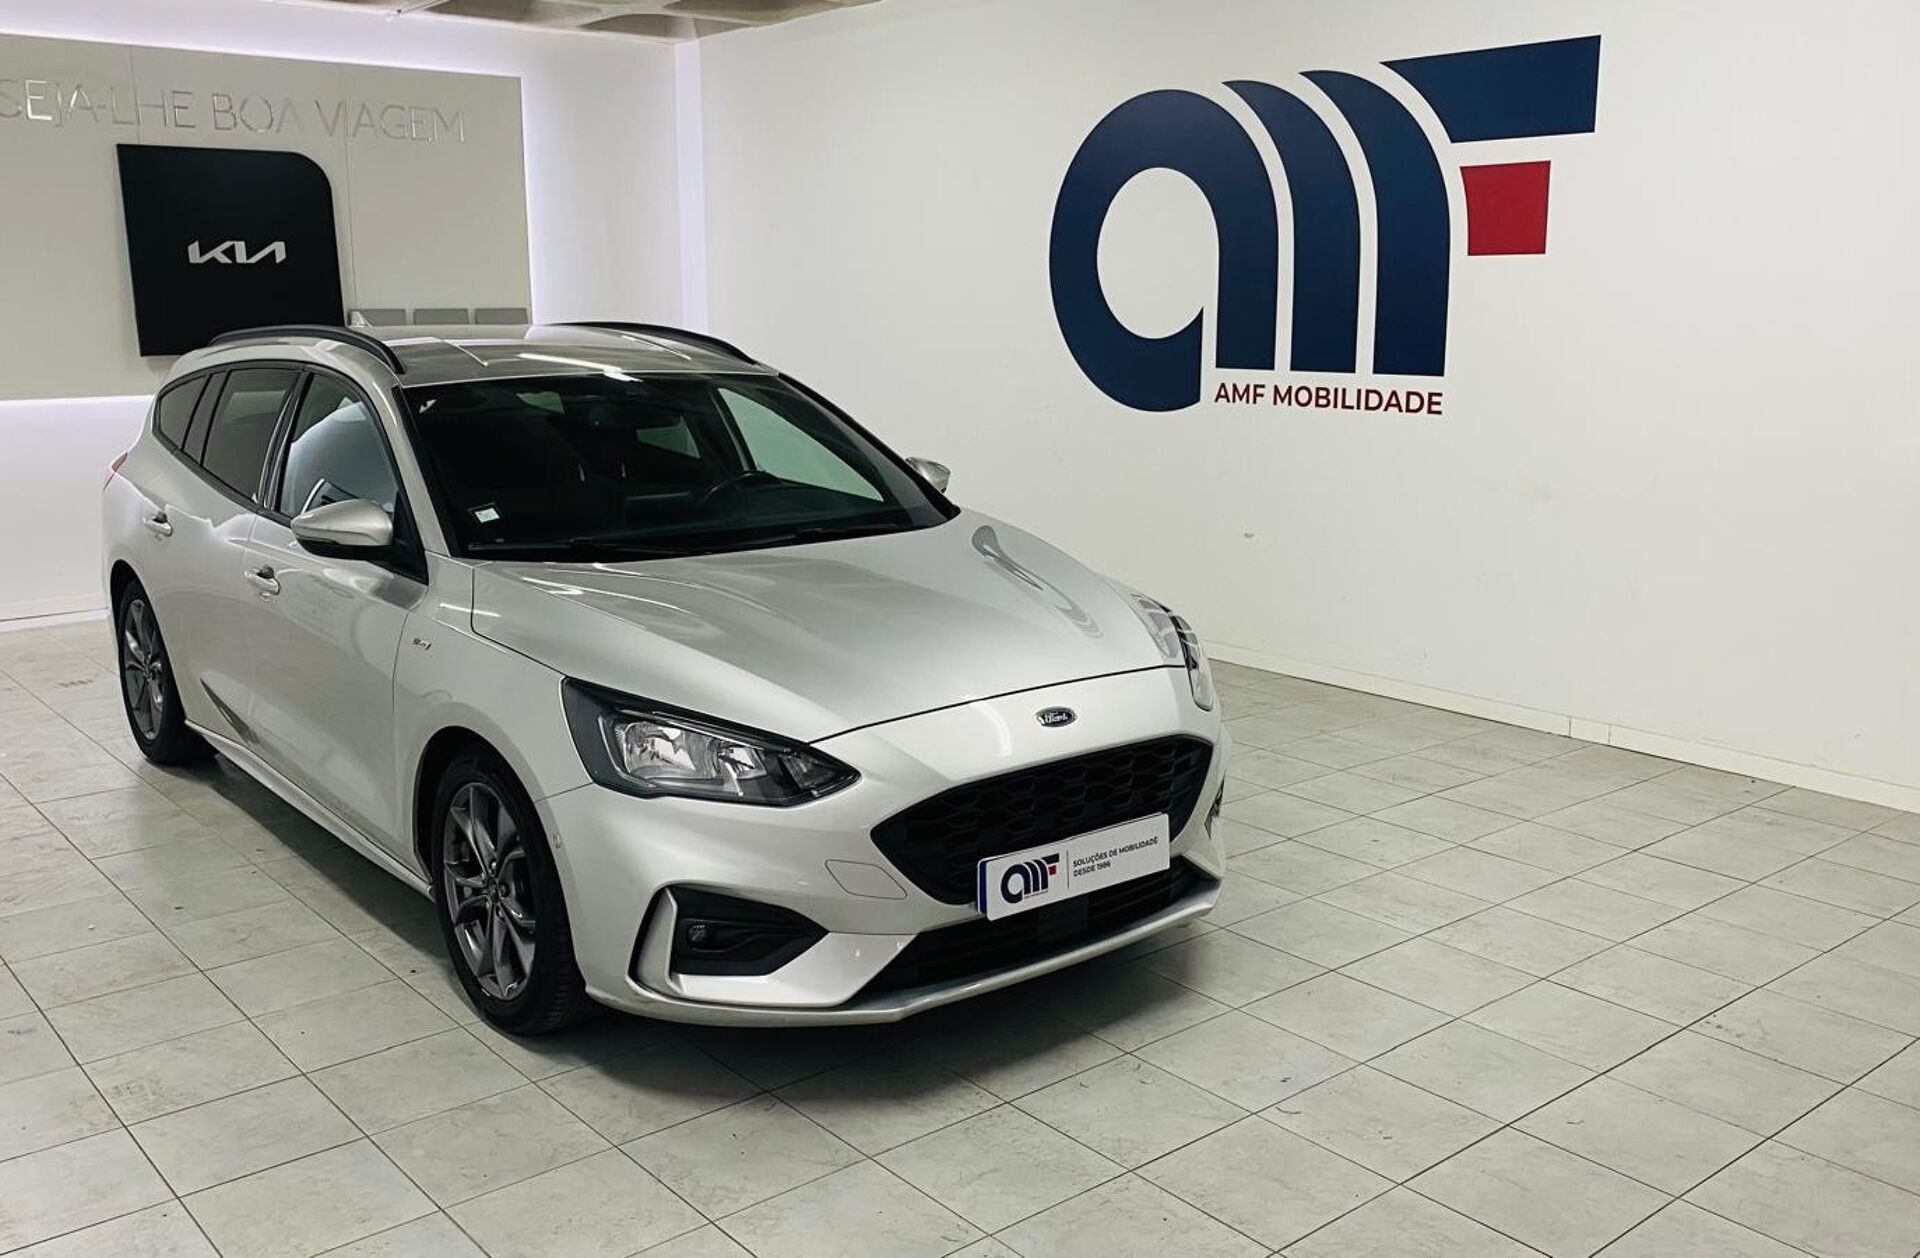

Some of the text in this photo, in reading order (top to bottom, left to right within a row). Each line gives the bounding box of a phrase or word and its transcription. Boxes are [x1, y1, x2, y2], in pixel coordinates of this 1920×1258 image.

[212, 93, 303, 134] BOA
[314, 99, 466, 144] VIAGEM
[187, 240, 287, 264] KIA
[1214, 382, 1444, 416] AMF MOBILIDADE
[1072, 836, 1158, 868] SOLUÇÕES DE MOBILIDADE
[1072, 864, 1096, 877] DESDE
